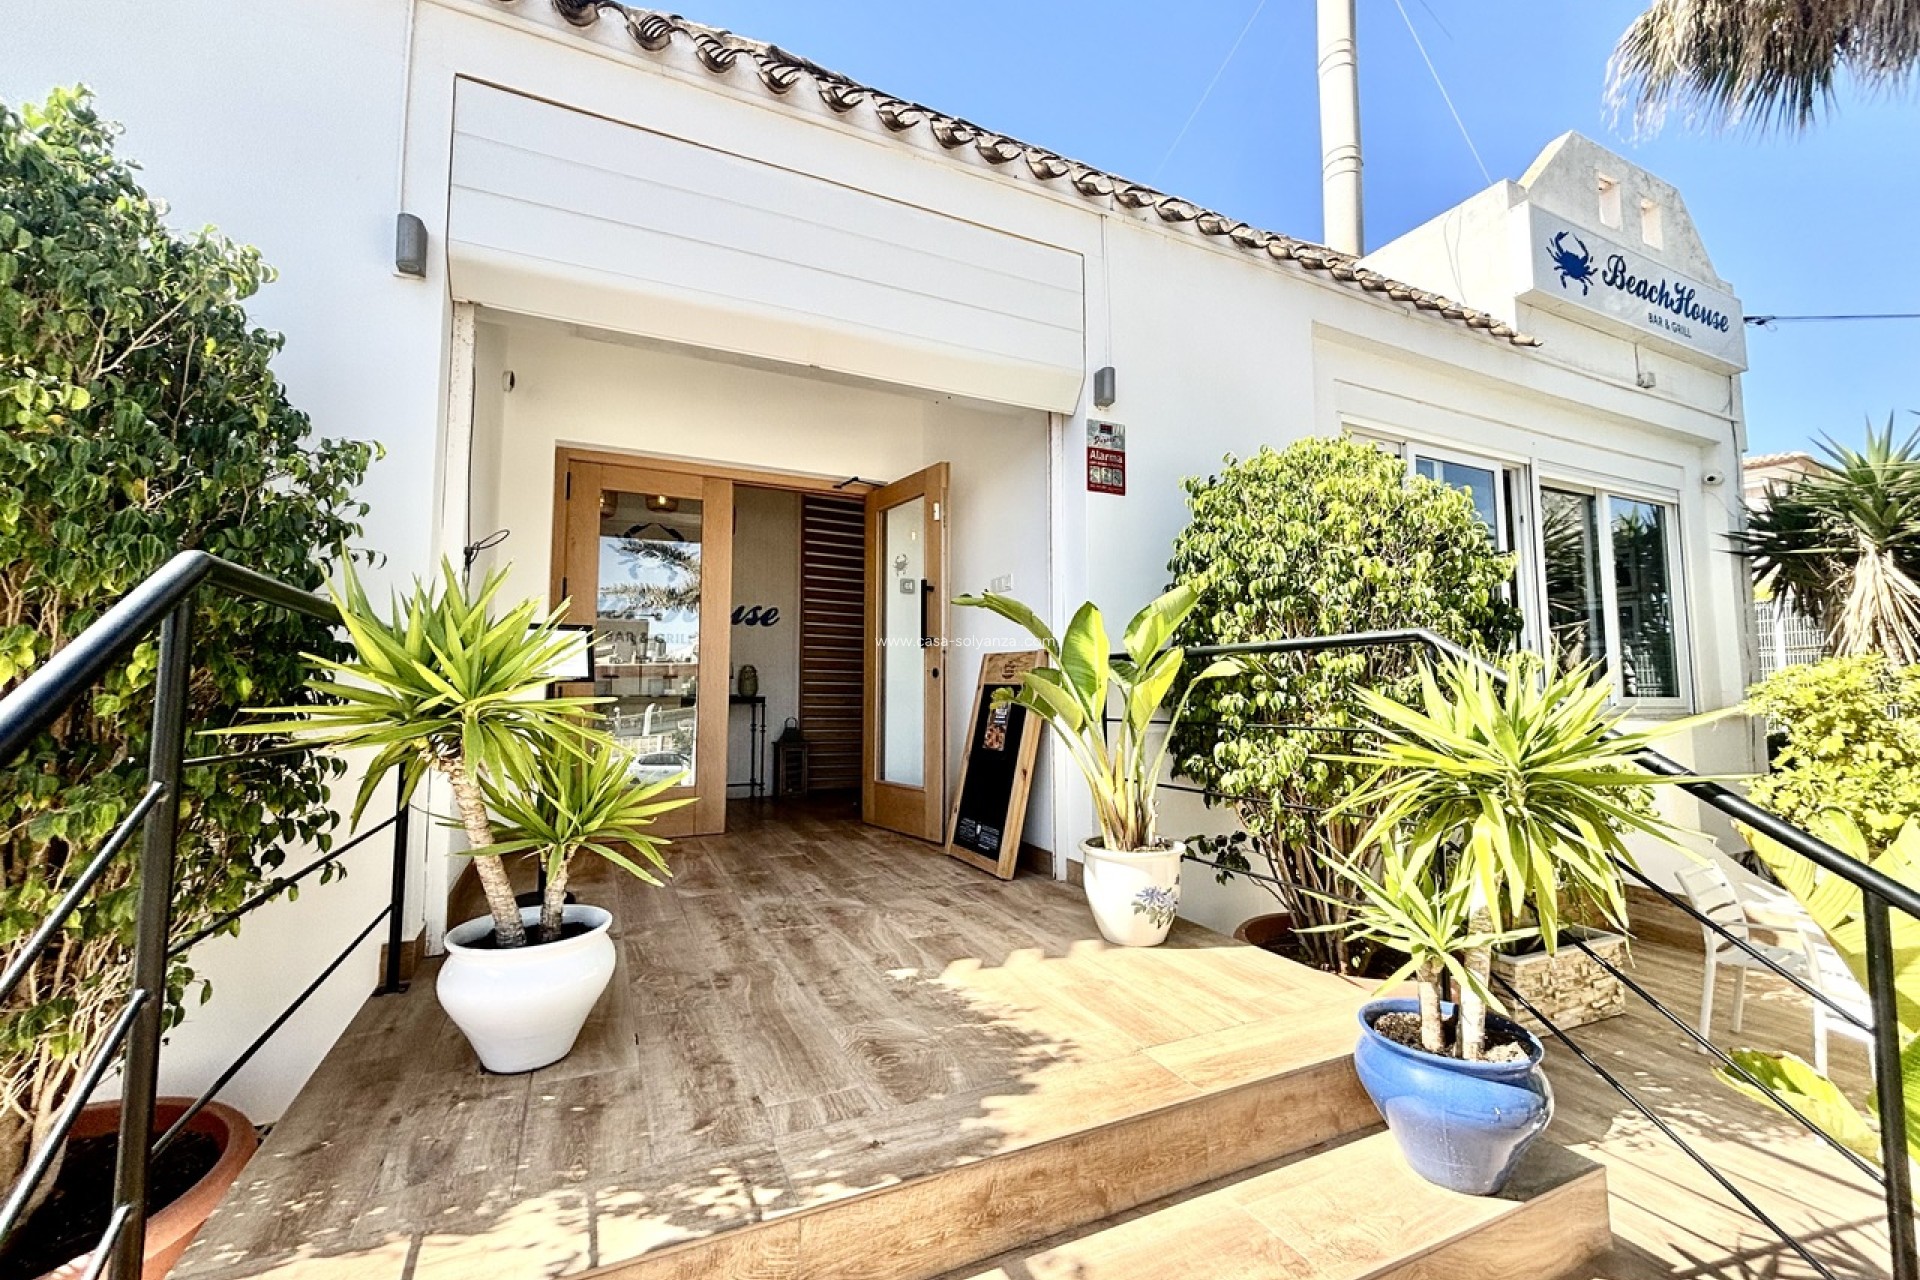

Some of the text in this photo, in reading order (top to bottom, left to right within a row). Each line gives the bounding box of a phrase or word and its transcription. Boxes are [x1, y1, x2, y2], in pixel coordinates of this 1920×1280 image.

[1648, 312, 1692, 338] BAR & GRILL
[1090, 450, 1123, 463] Alarma
